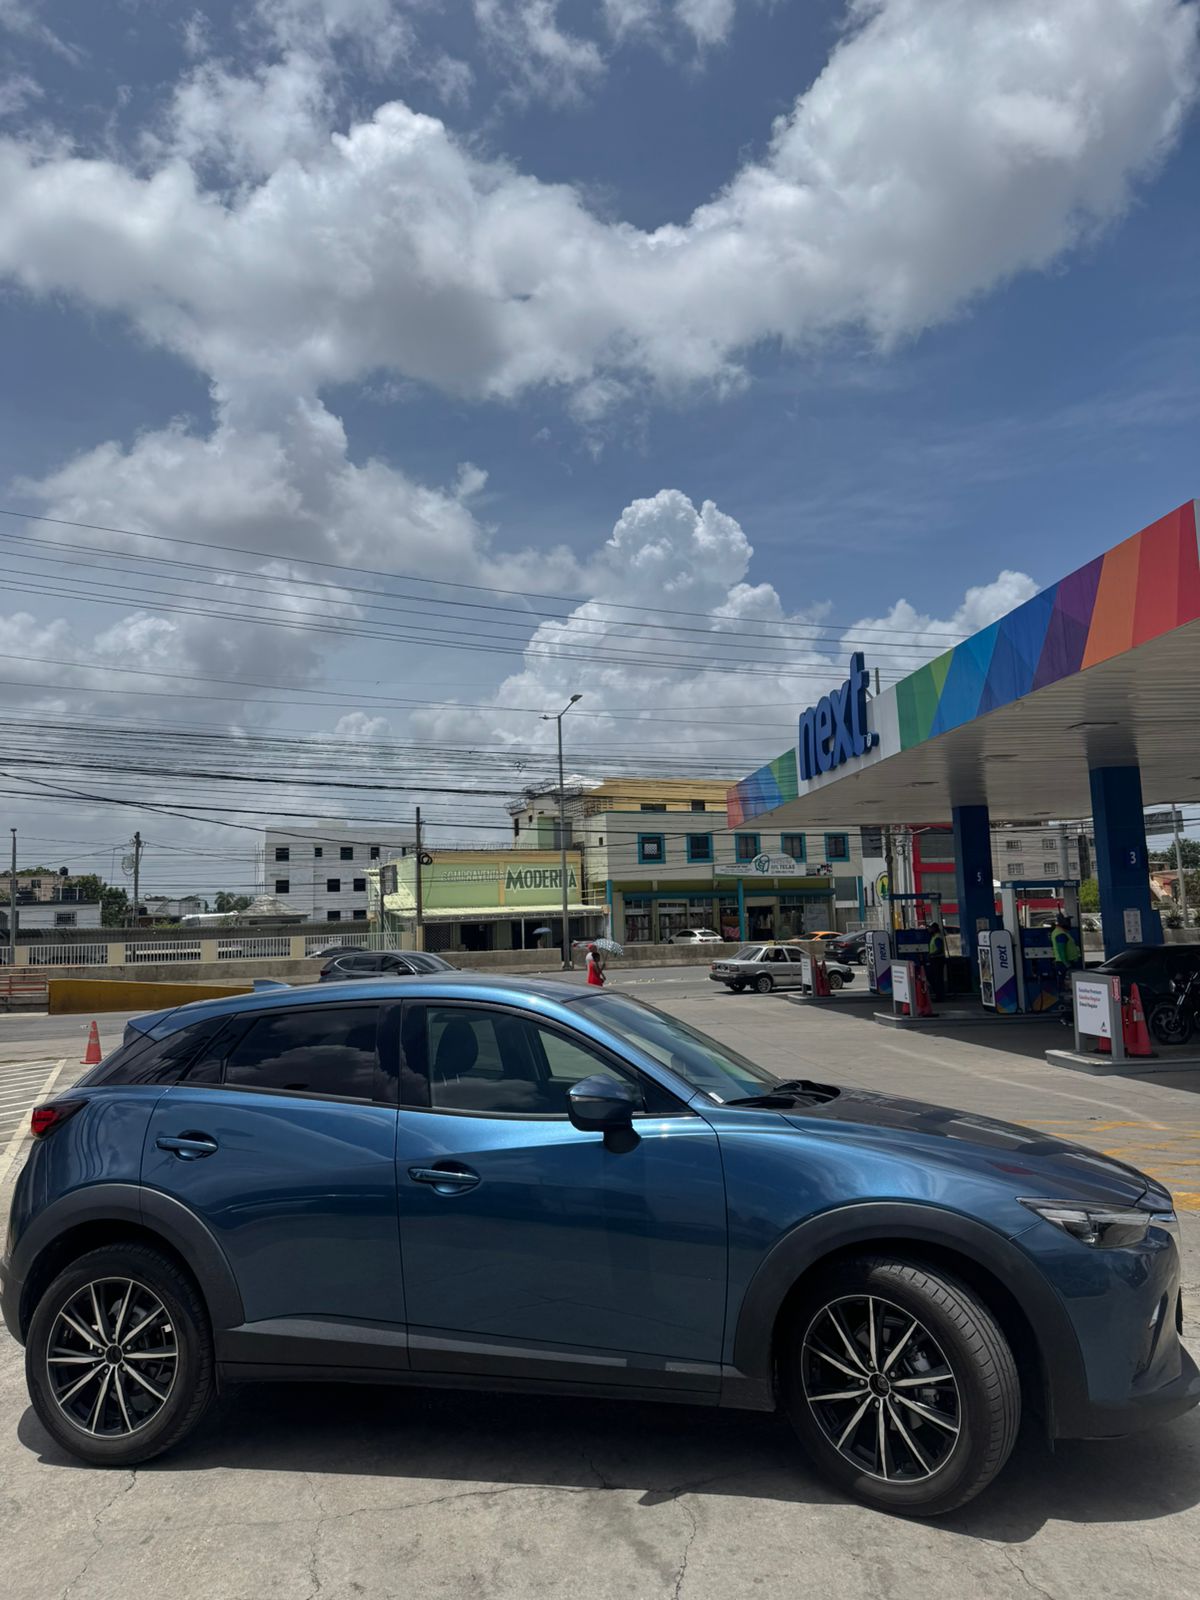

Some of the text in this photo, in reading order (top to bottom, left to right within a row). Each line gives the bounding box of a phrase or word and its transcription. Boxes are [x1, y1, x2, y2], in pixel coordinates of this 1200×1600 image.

[1129, 851, 1137, 865] 3
[977, 871, 982, 883] 5
[878, 942, 887, 961] next
[996, 944, 1009, 969] next
